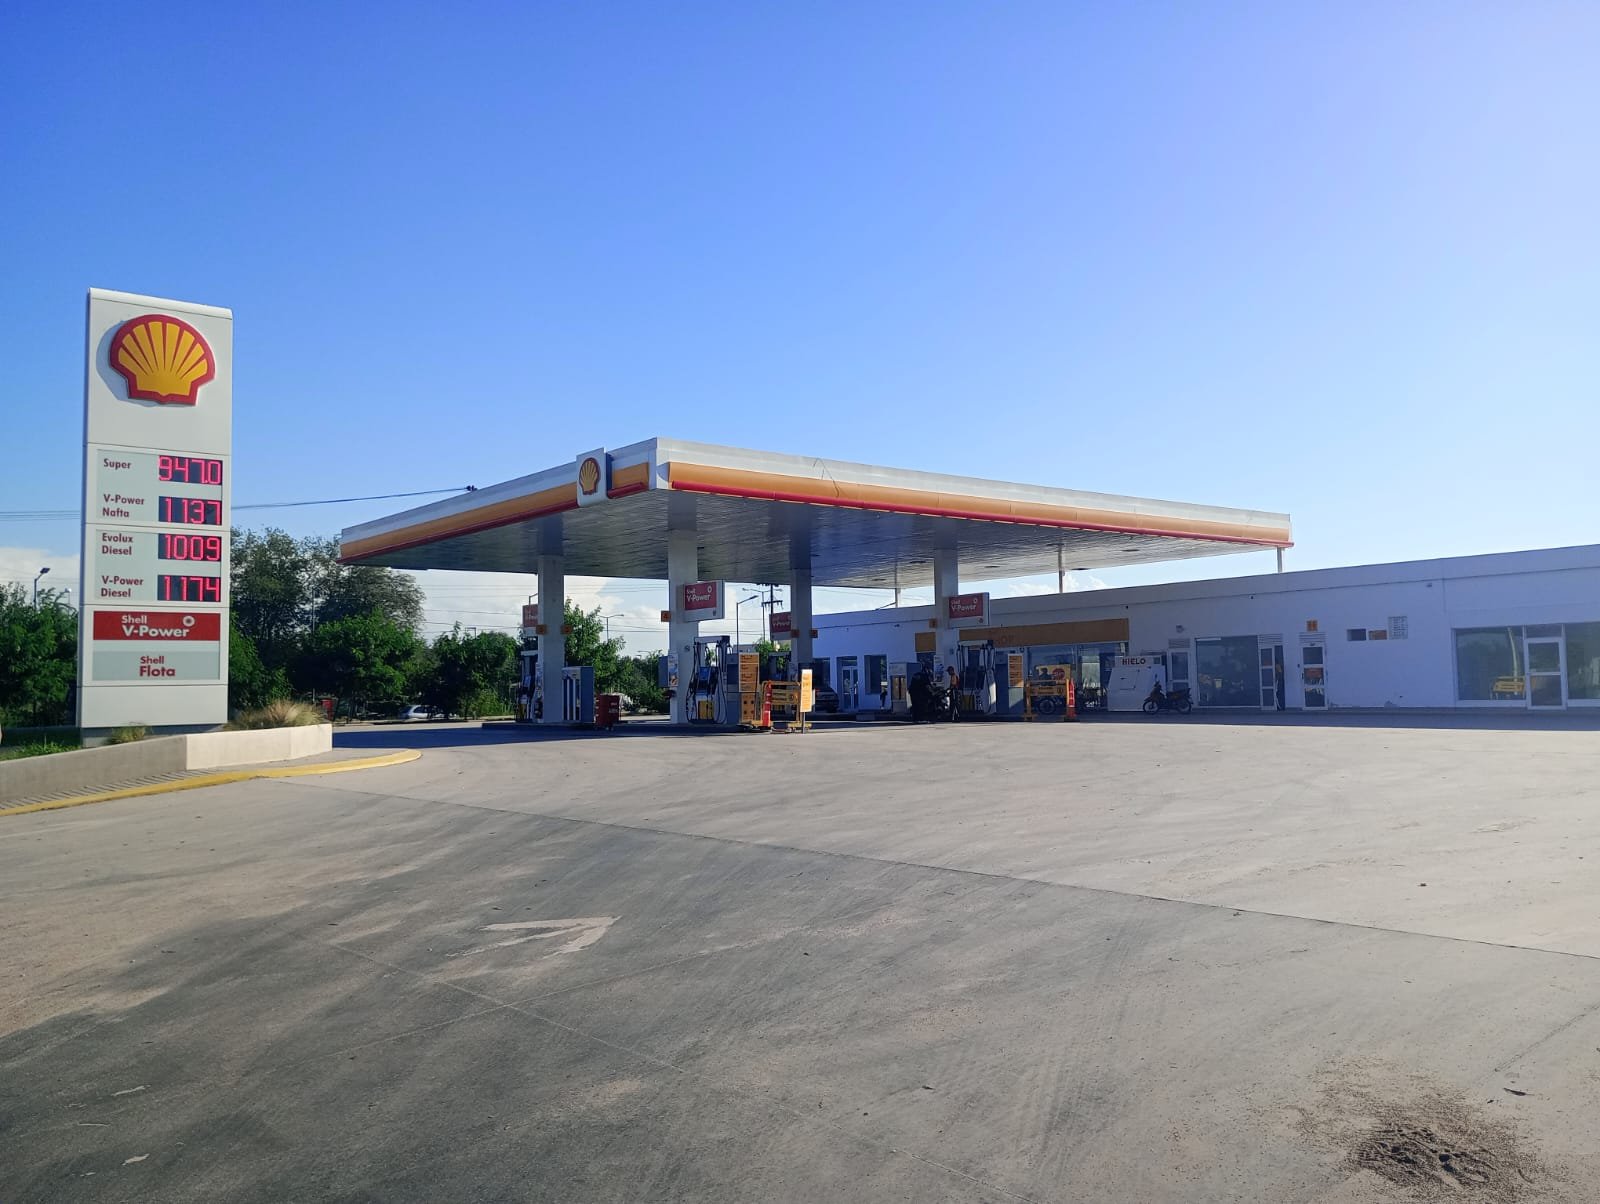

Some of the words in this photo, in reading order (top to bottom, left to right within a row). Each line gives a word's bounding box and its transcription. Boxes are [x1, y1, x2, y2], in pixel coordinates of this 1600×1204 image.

[104, 458, 132, 470] Super
[103, 494, 145, 506] V-Power
[102, 508, 130, 518] Nafta
[165, 498, 221, 525] 1137
[102, 533, 134, 543] Evolux
[102, 545, 132, 556] Diesel
[165, 534, 220, 561] 1009
[102, 575, 144, 586] V-Power
[101, 588, 132, 598] Diesel
[164, 576, 220, 602] 1174
[687, 594, 711, 602] V-Power
[121, 615, 147, 625] Shell
[122, 625, 189, 638] V-Power
[140, 654, 165, 664] Shell
[139, 665, 176, 677] Flota
